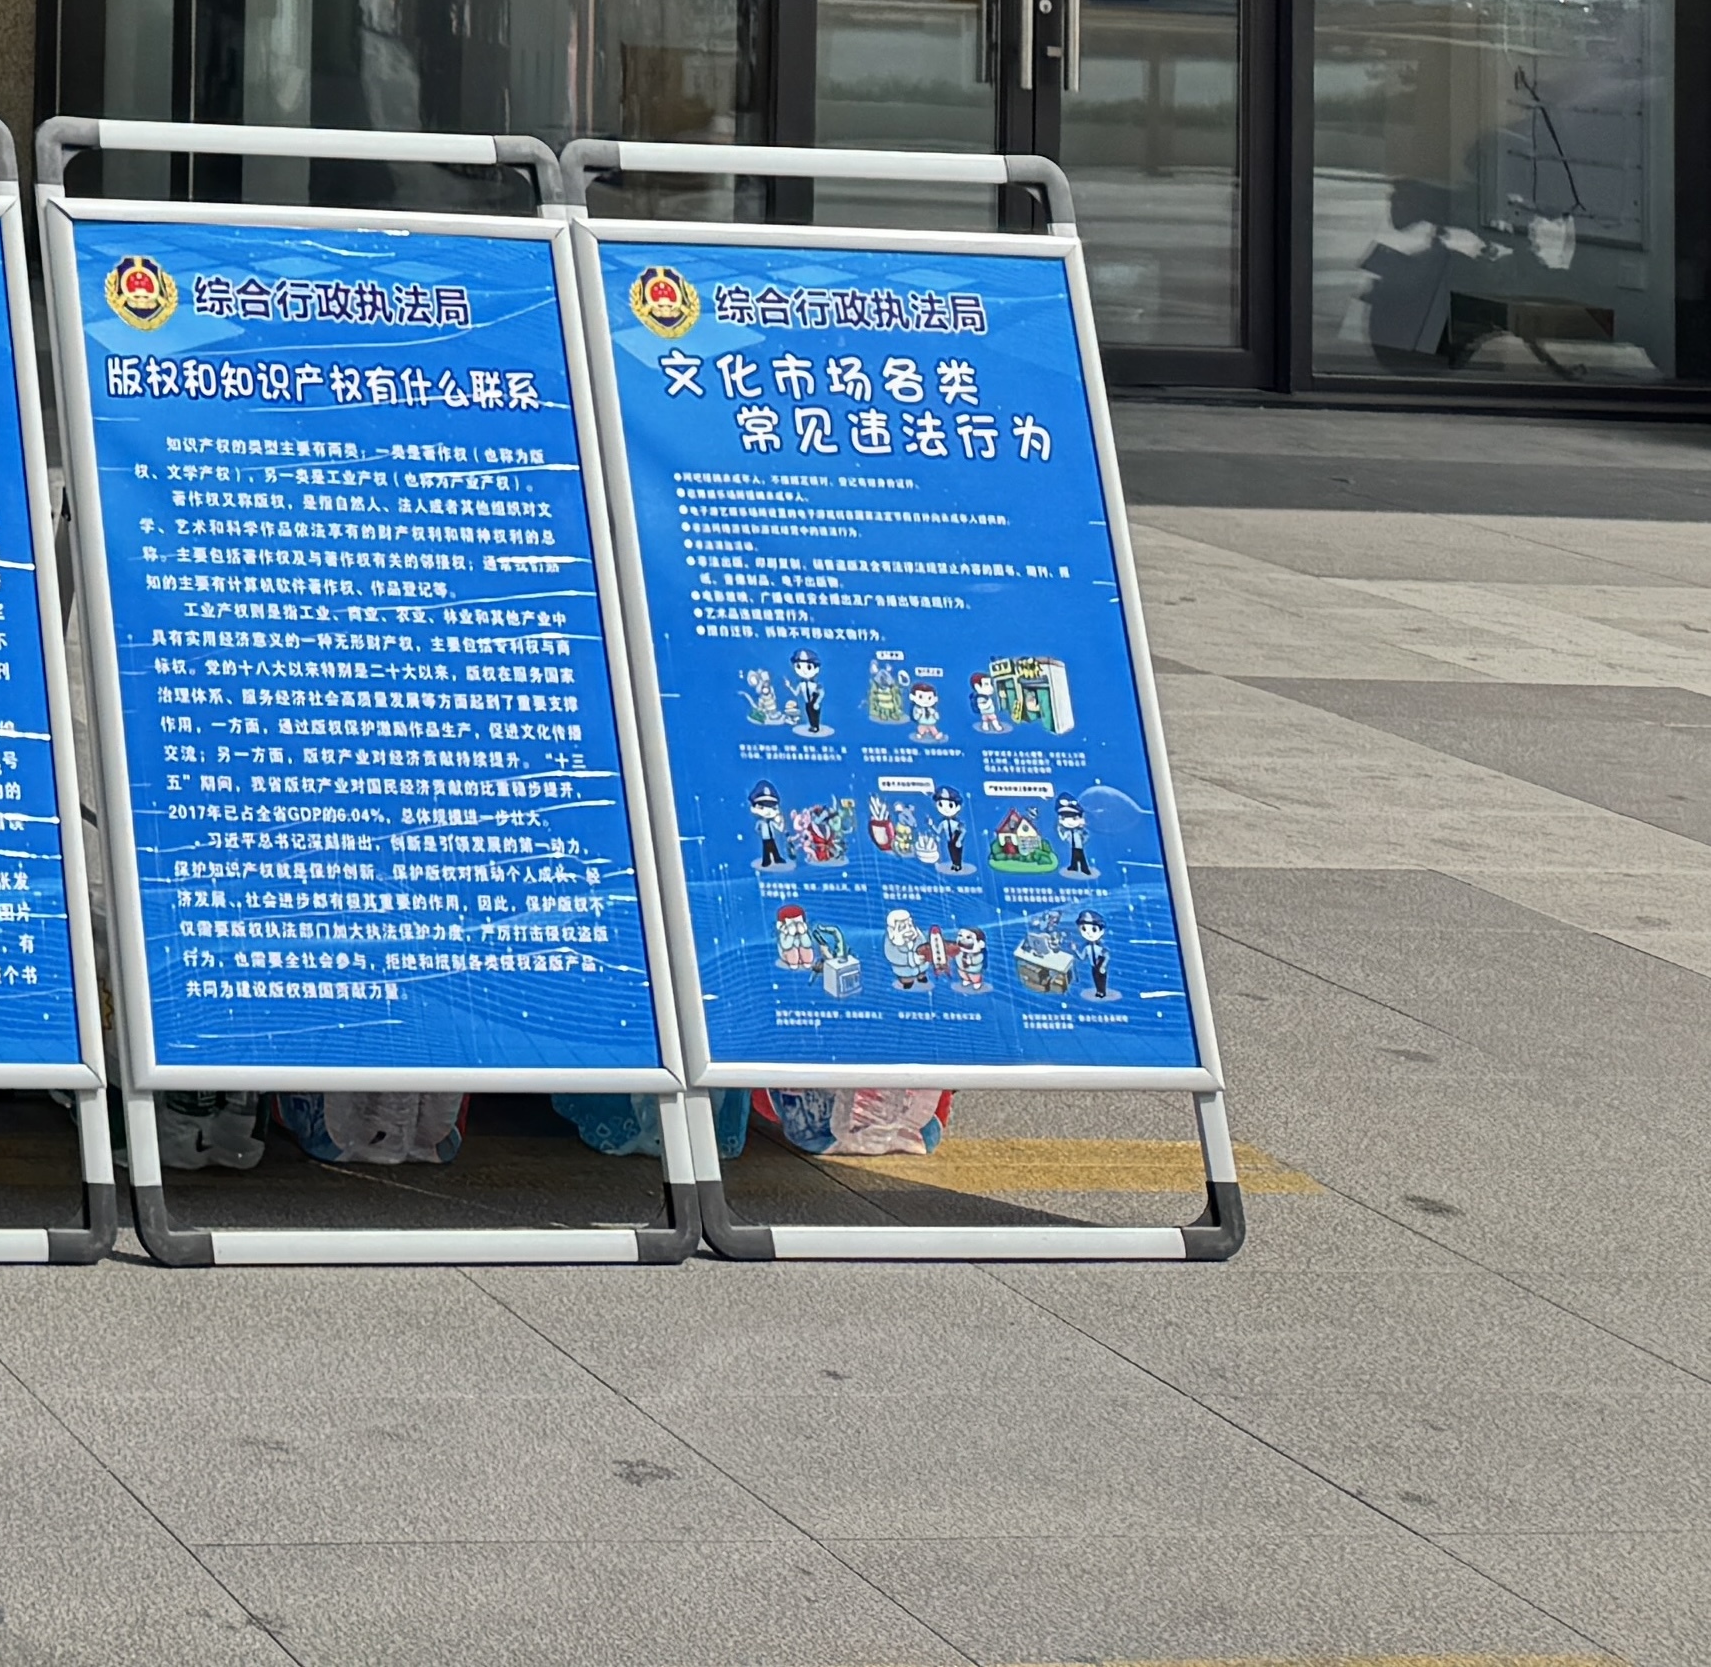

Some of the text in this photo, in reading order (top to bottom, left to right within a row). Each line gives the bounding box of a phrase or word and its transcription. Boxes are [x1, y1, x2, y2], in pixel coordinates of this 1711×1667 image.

[192, 274, 472, 327] 综合行政执法局
[713, 285, 989, 334] 综合行政执法局
[105, 355, 541, 411] 版权和知识产权有什么联系
[659, 350, 981, 406] 文化市场各类
[736, 405, 1053, 462] 常见违法行为
